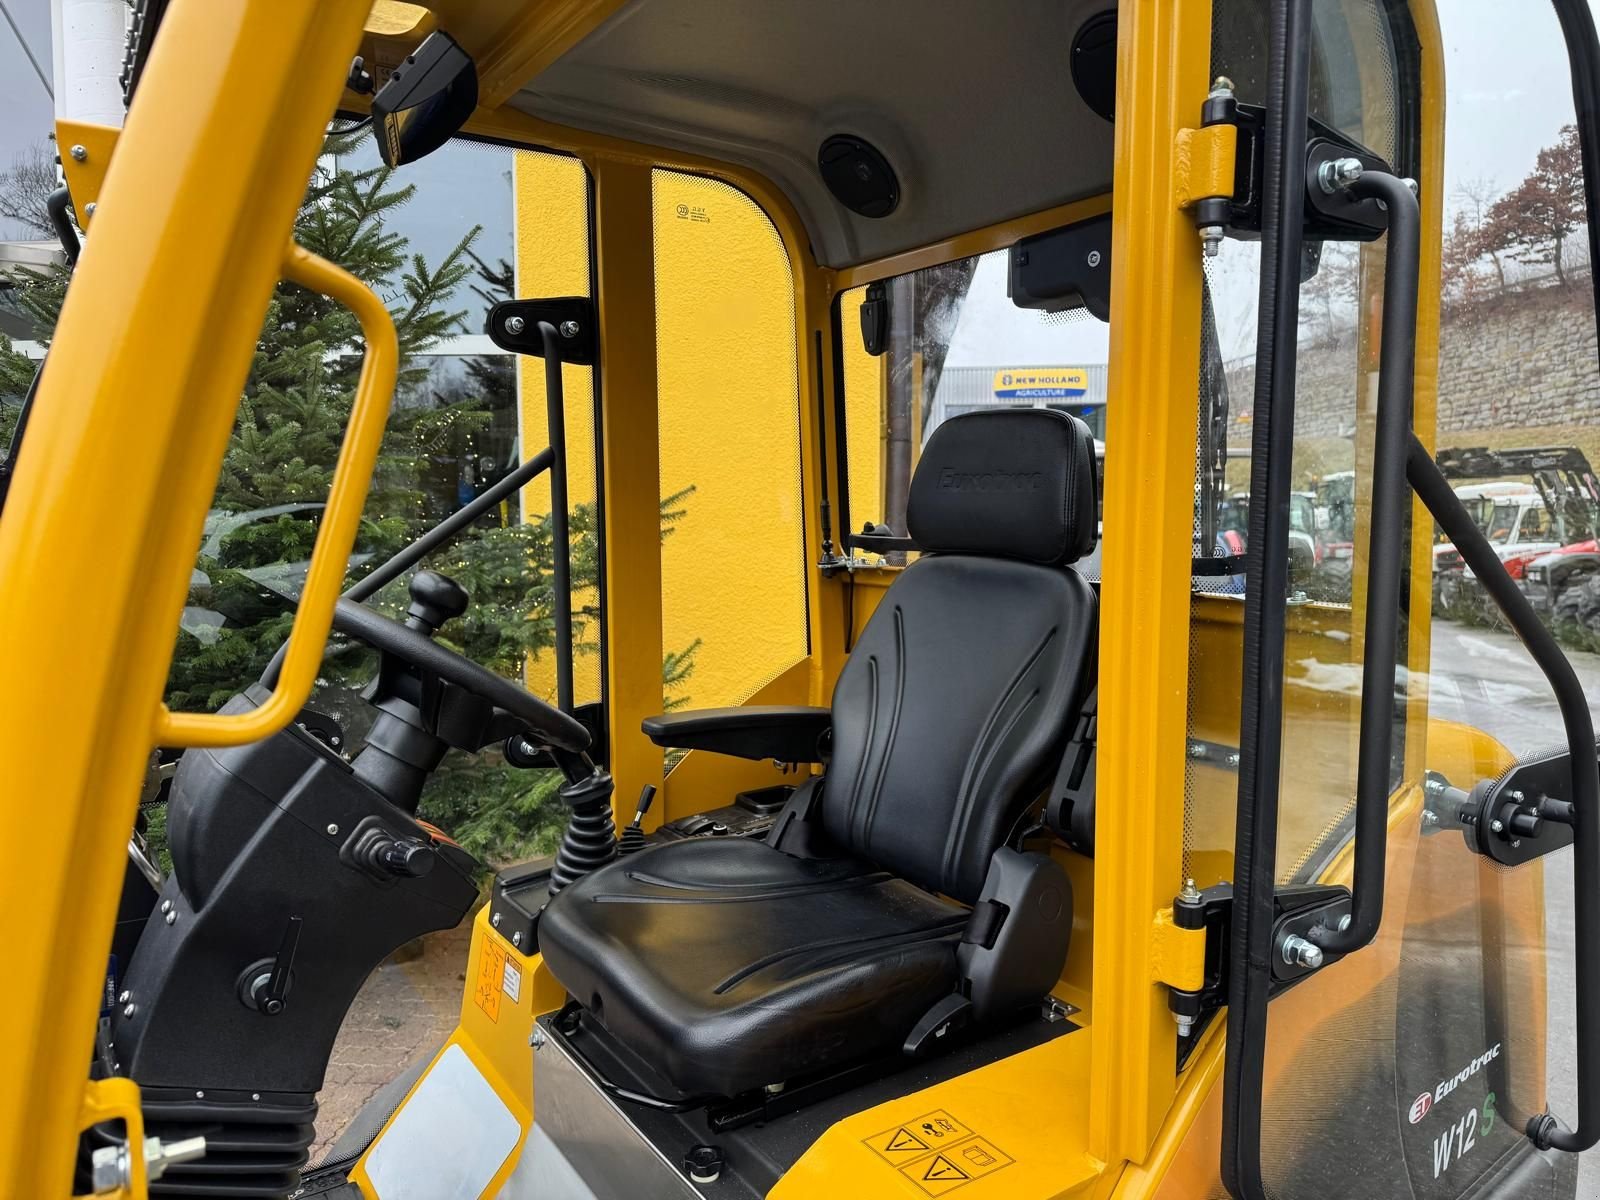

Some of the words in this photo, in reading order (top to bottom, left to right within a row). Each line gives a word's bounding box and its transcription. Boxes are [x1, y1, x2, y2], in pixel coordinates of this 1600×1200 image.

[1015, 376, 1037, 384] NEW
[1038, 375, 1081, 384] HOLLAND
[1015, 389, 1066, 397] AGRICULTURE
[1433, 1043, 1501, 1105] Eurotrac
[1433, 1107, 1478, 1180] W12
[1480, 1091, 1496, 1137] S
